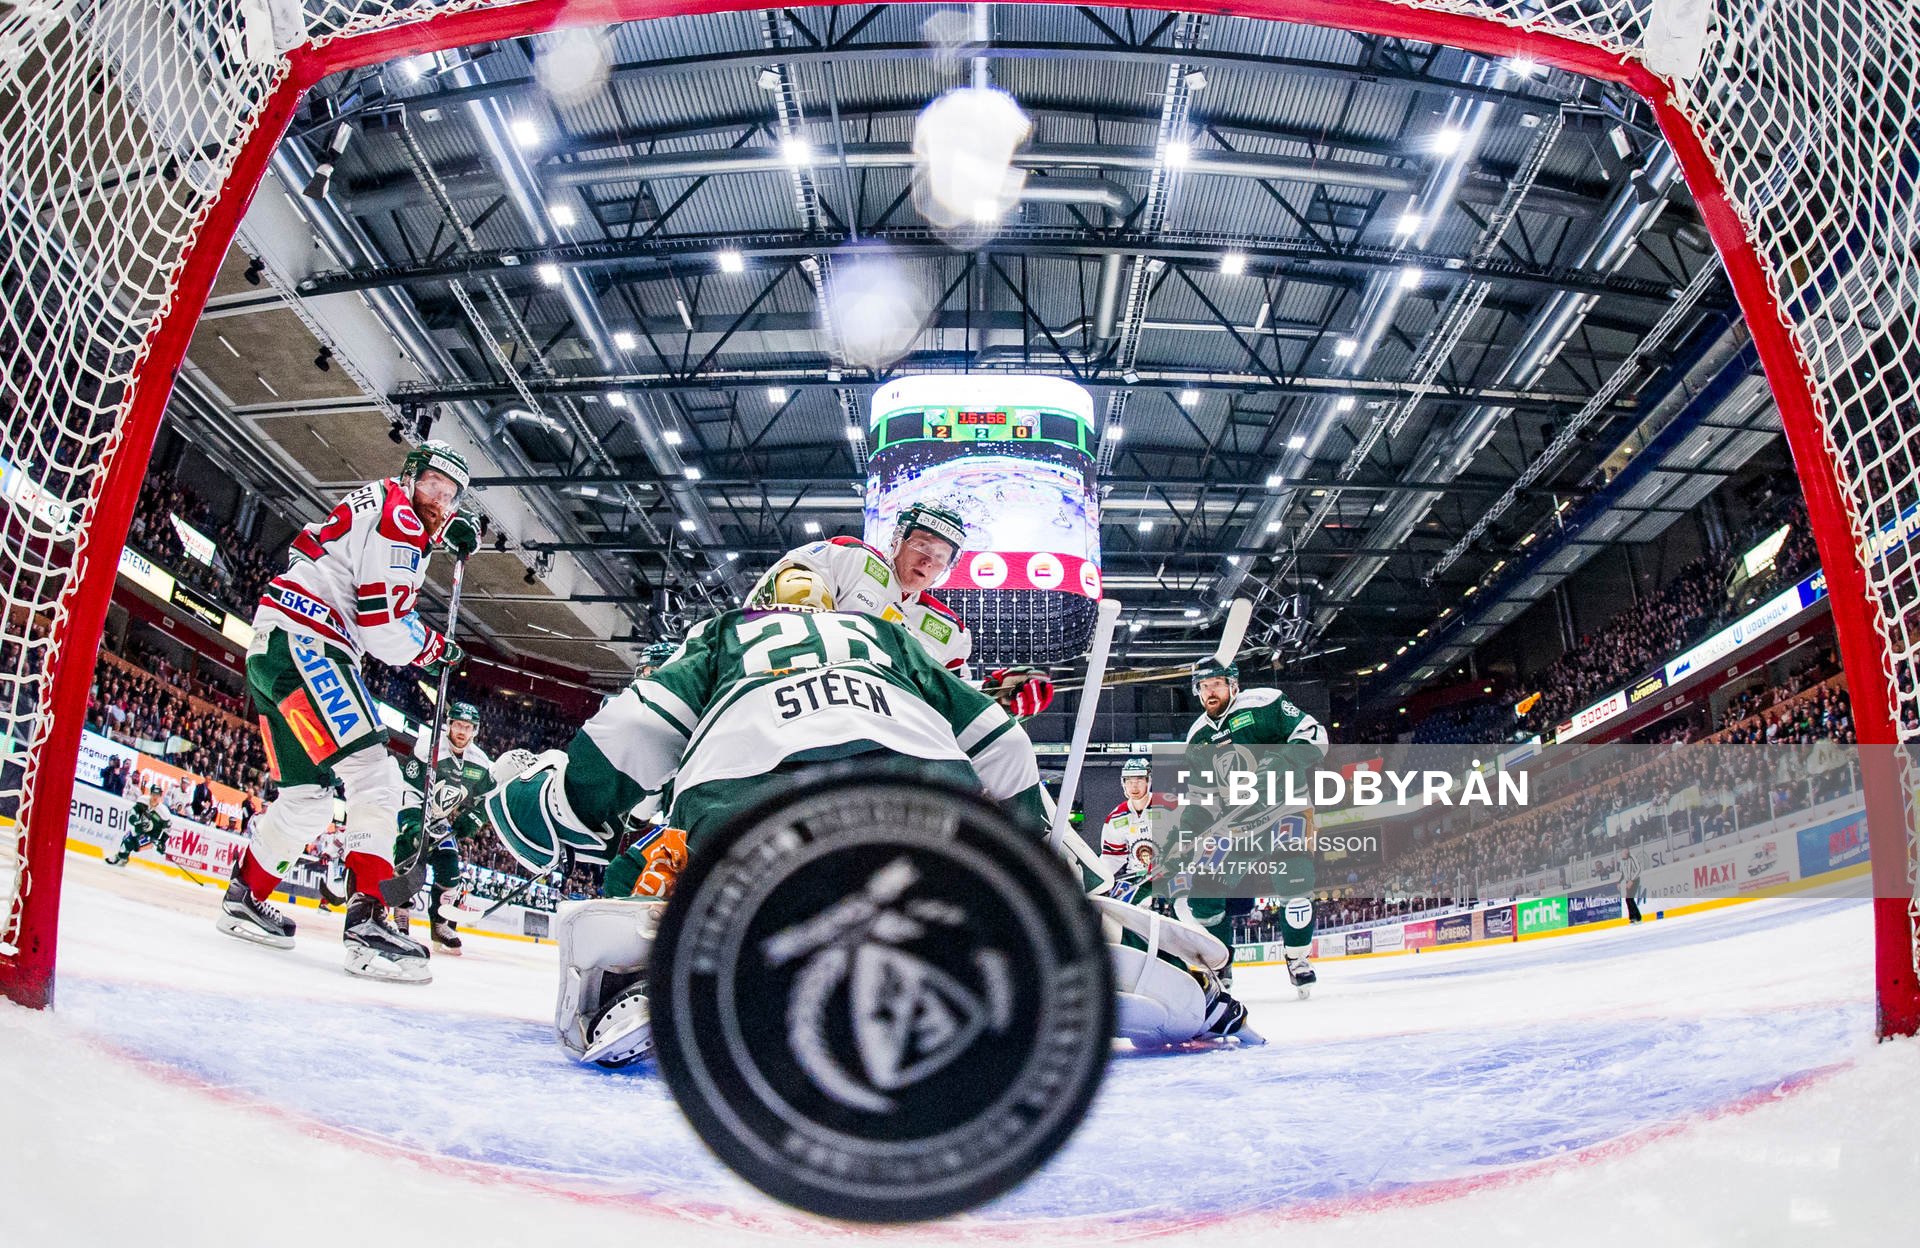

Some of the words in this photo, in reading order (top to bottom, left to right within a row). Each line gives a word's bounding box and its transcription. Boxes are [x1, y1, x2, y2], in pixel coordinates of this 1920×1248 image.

[937, 426, 947, 437] 2
[959, 412, 1007, 425] 15:56
[1016, 426, 1027, 437] 0
[122, 548, 151, 576] STENA
[281, 590, 329, 618] SKF
[295, 646, 360, 738] STENA
[774, 670, 894, 720] STÉEN
[108, 807, 128, 832] Bil
[168, 829, 208, 857] KEWAB
[1693, 862, 1737, 889] MAXI
[1651, 882, 1689, 898] MIDROC
[1523, 899, 1561, 931] print
[1436, 924, 1470, 941] LÖFBERGS
